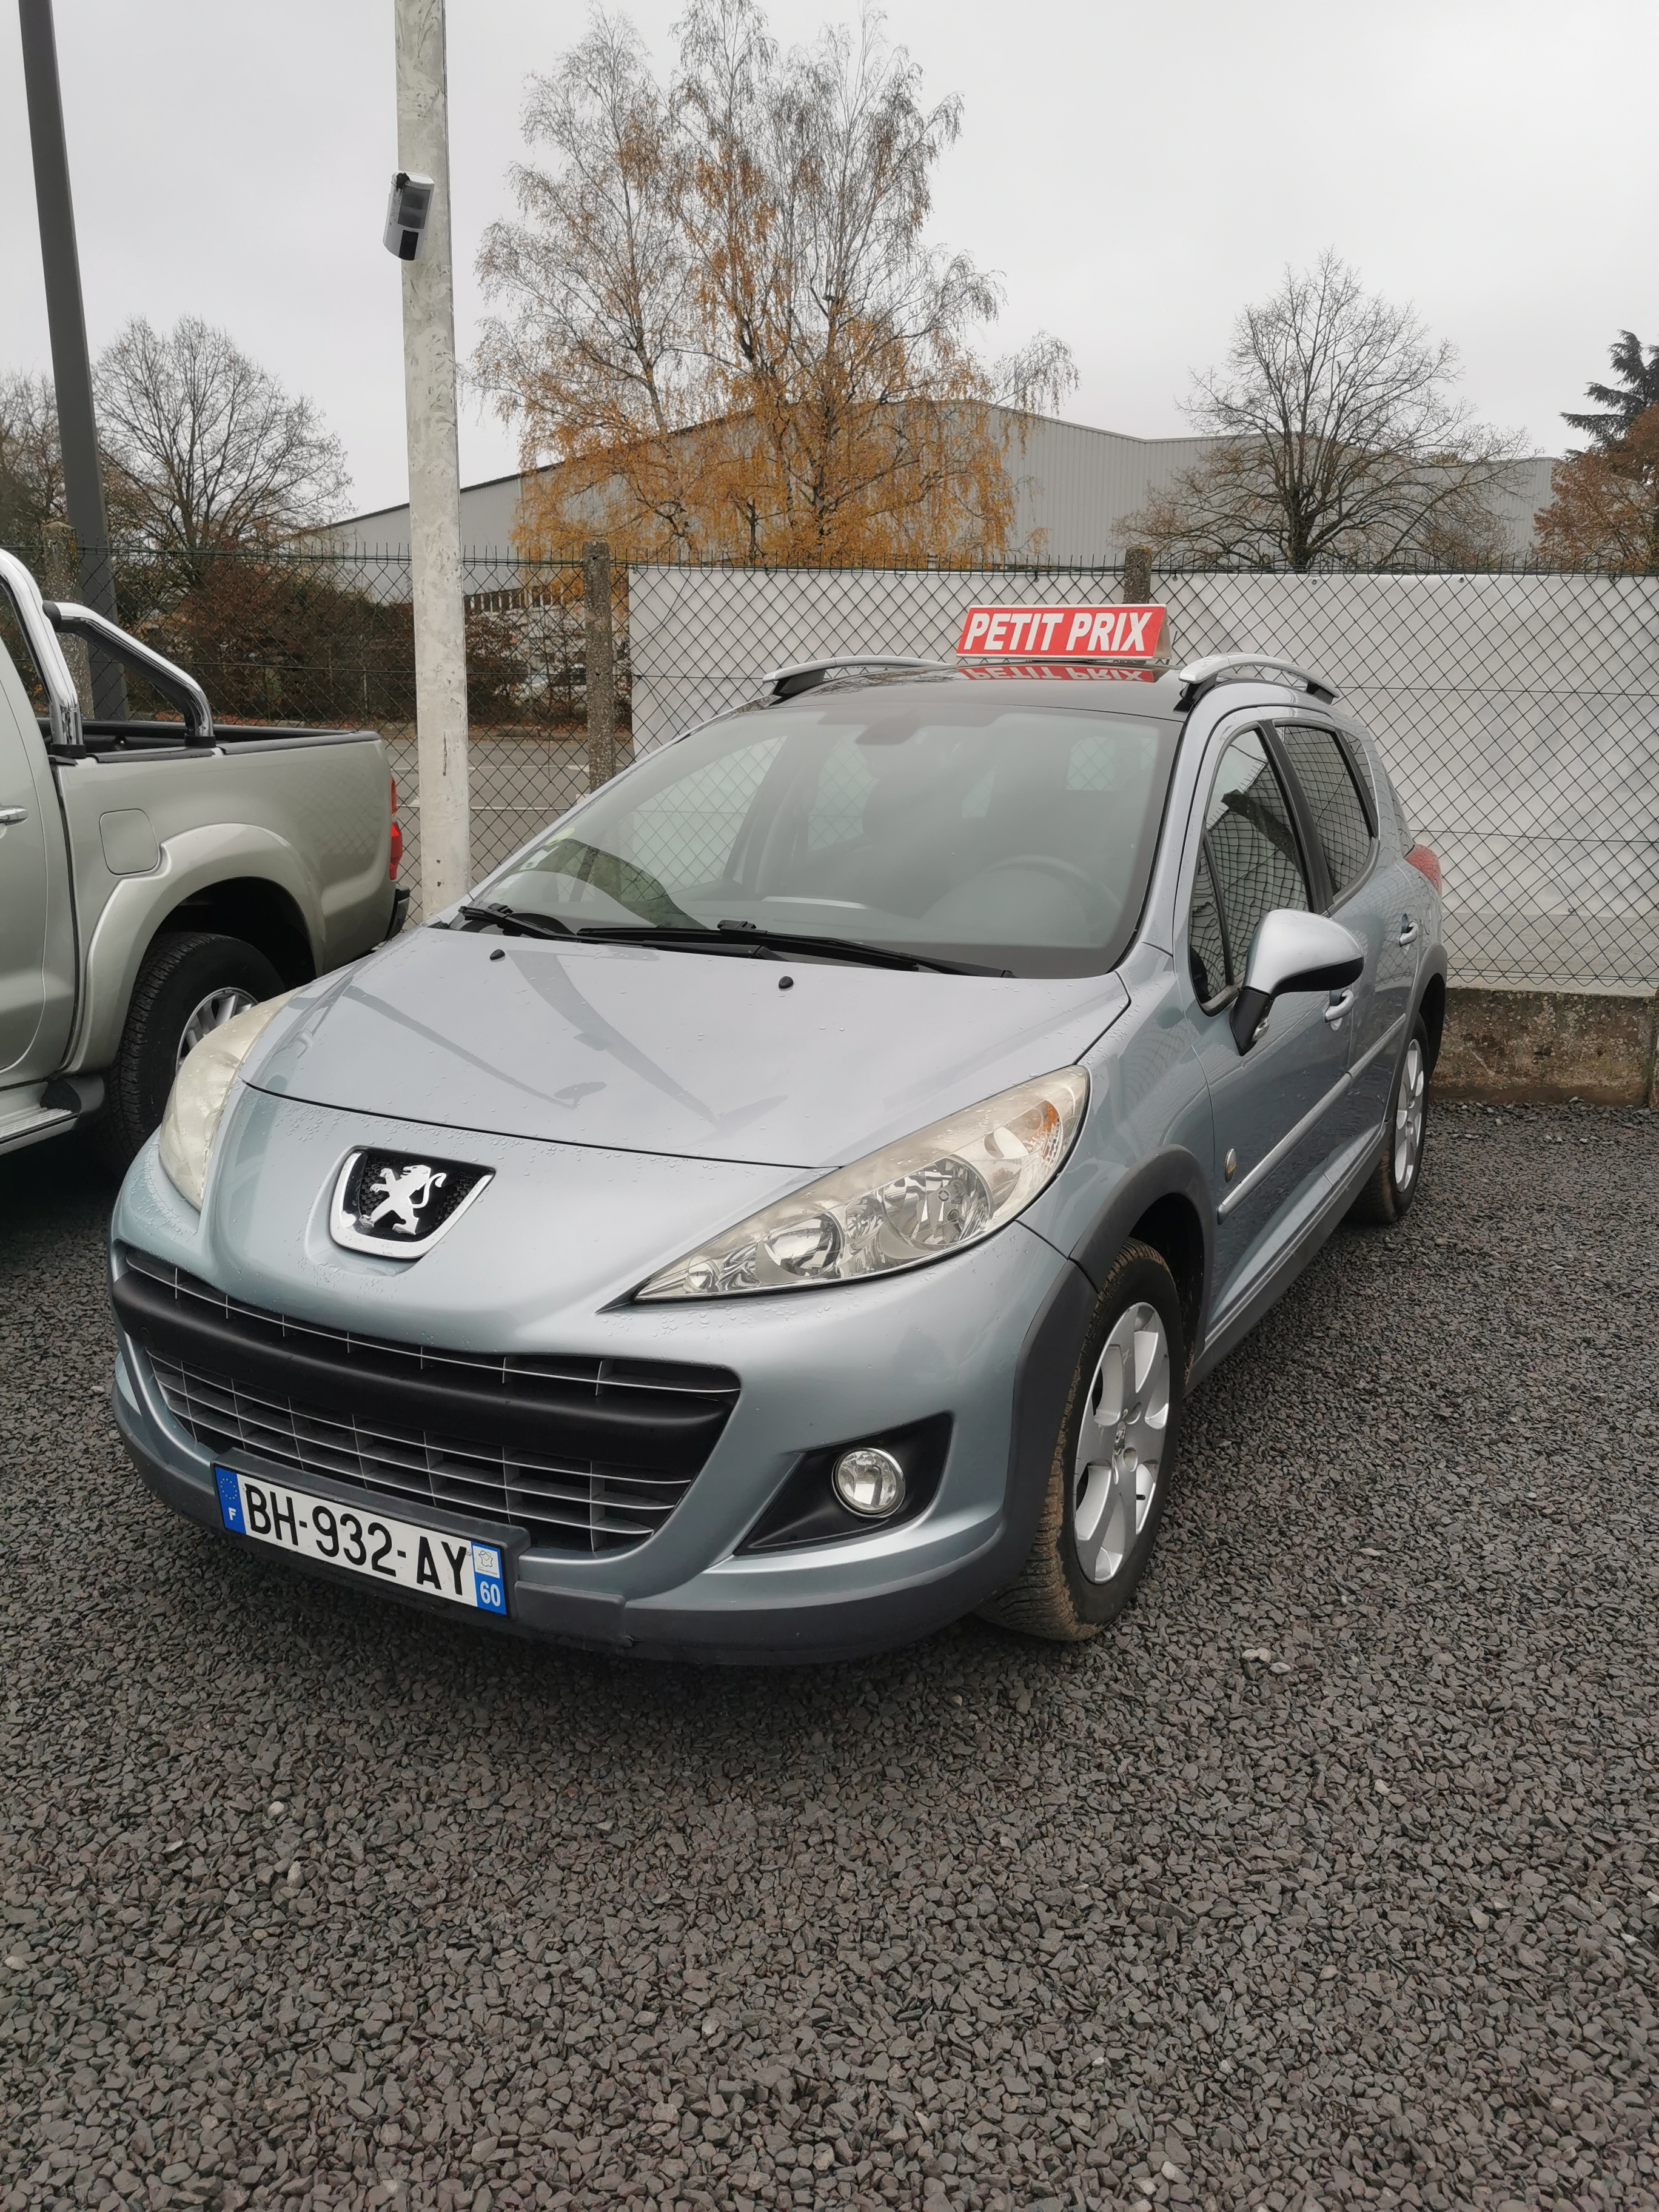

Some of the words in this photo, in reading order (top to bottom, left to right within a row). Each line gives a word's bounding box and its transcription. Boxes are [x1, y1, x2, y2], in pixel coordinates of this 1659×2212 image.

[964, 613, 1064, 651] PETIT
[1065, 612, 1153, 651] PRIX
[228, 1507, 236, 1521] F
[244, 1483, 468, 1596] BH-932-AY
[480, 1581, 501, 1607] 60
